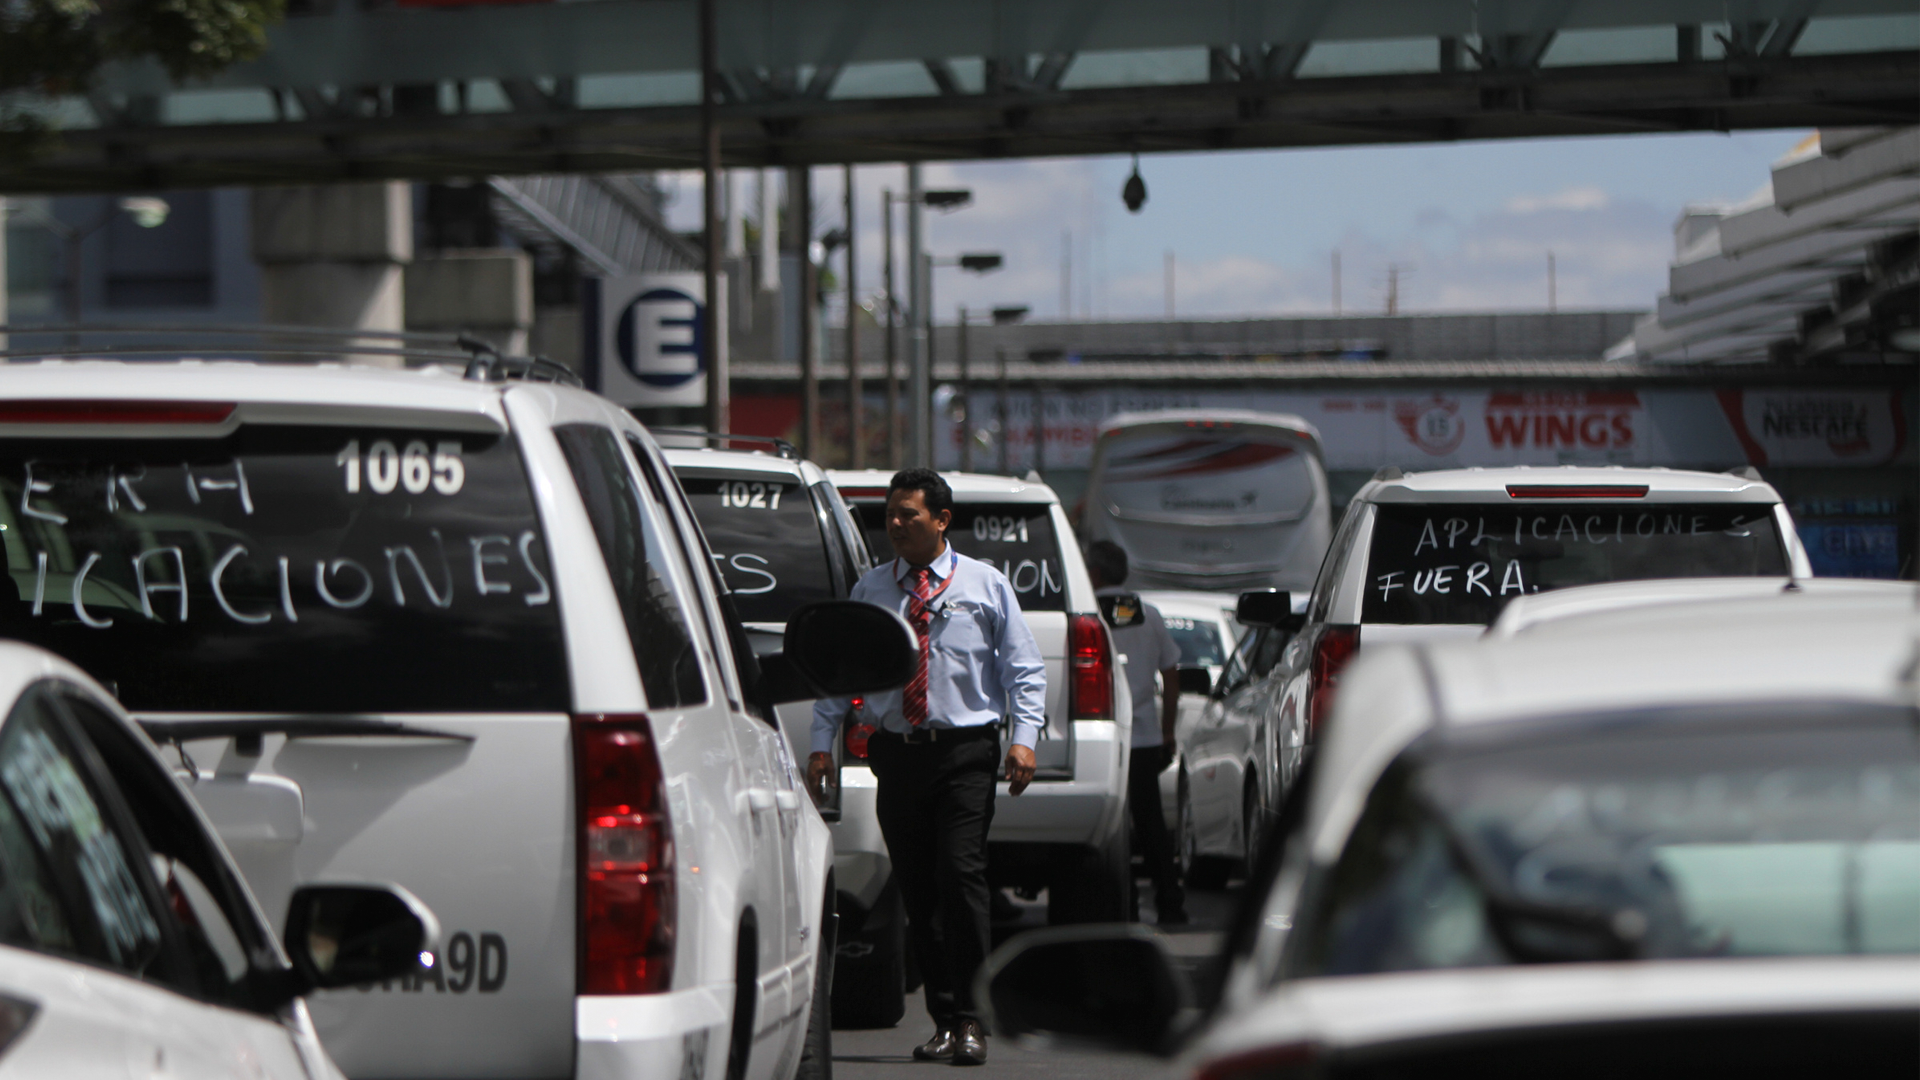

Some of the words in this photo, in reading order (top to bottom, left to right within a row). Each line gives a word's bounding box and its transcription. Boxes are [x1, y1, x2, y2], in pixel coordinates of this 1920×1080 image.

[634, 300, 698, 375] E
[1485, 413, 1634, 447] WINGS
[338, 440, 464, 494] 1065
[718, 482, 783, 510] 1027
[973, 515, 1029, 543] 0921
[1414, 513, 1753, 556] APLICACIONES
[32, 531, 550, 629] ICACIONES
[711, 551, 778, 595] S
